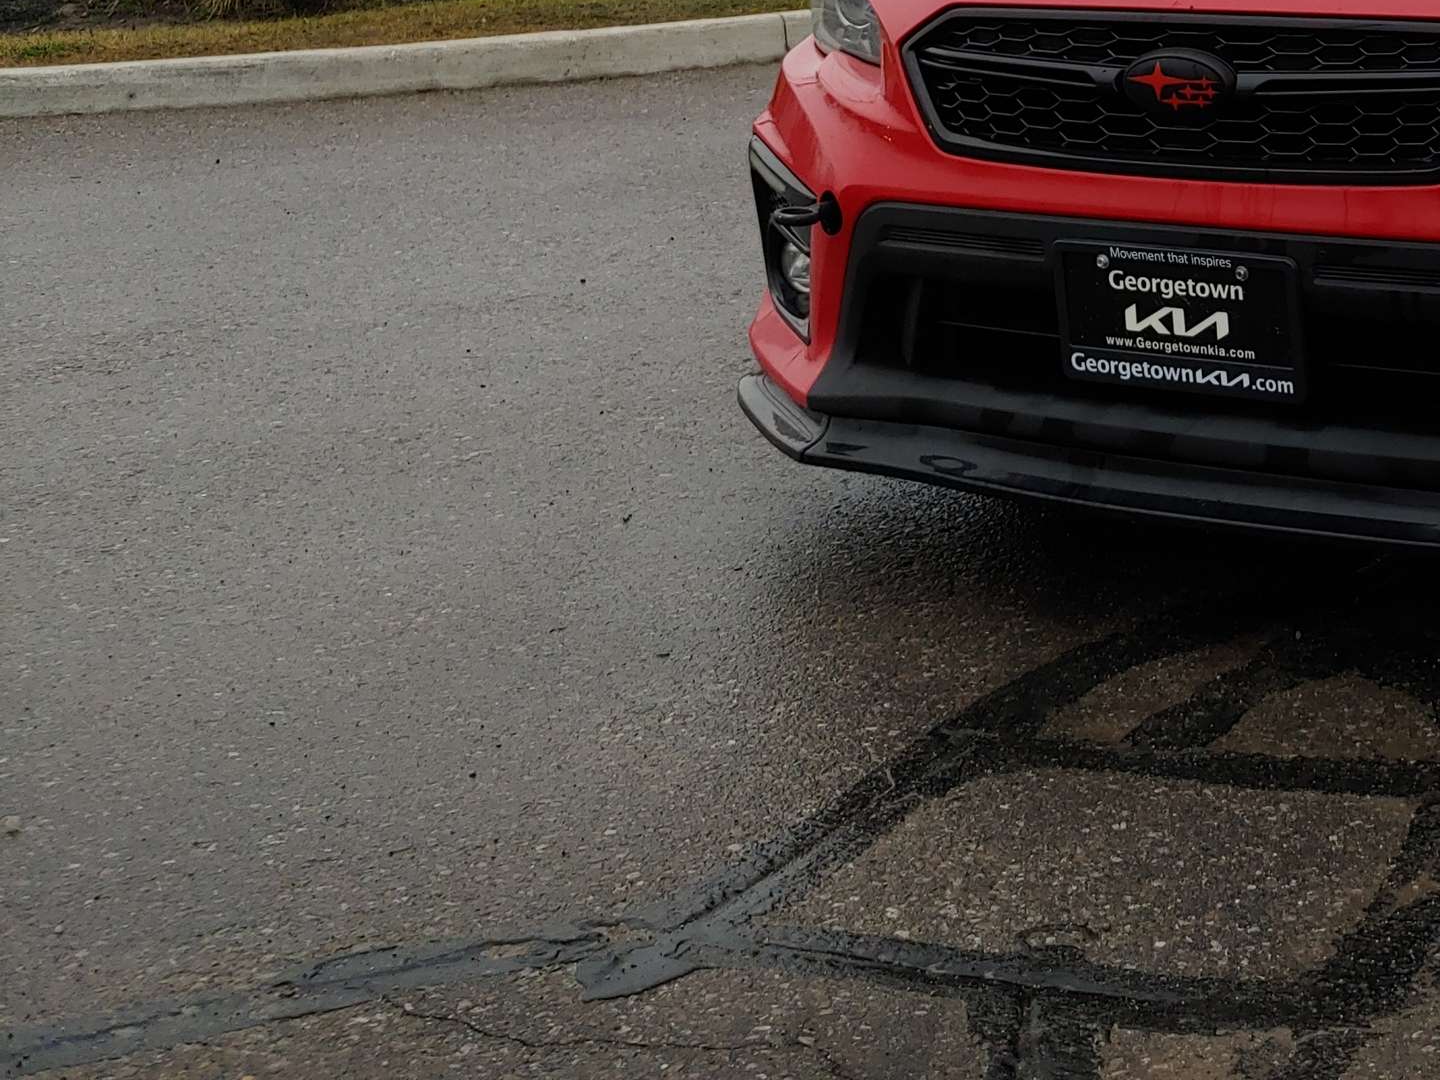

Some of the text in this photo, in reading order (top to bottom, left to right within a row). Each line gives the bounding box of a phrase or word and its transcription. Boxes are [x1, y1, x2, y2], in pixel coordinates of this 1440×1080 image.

[1109, 247, 1232, 269] Movement that inspires
[1108, 270, 1244, 300] Georgetown
[1106, 336, 1256, 360] www.Georgetownkia.com
